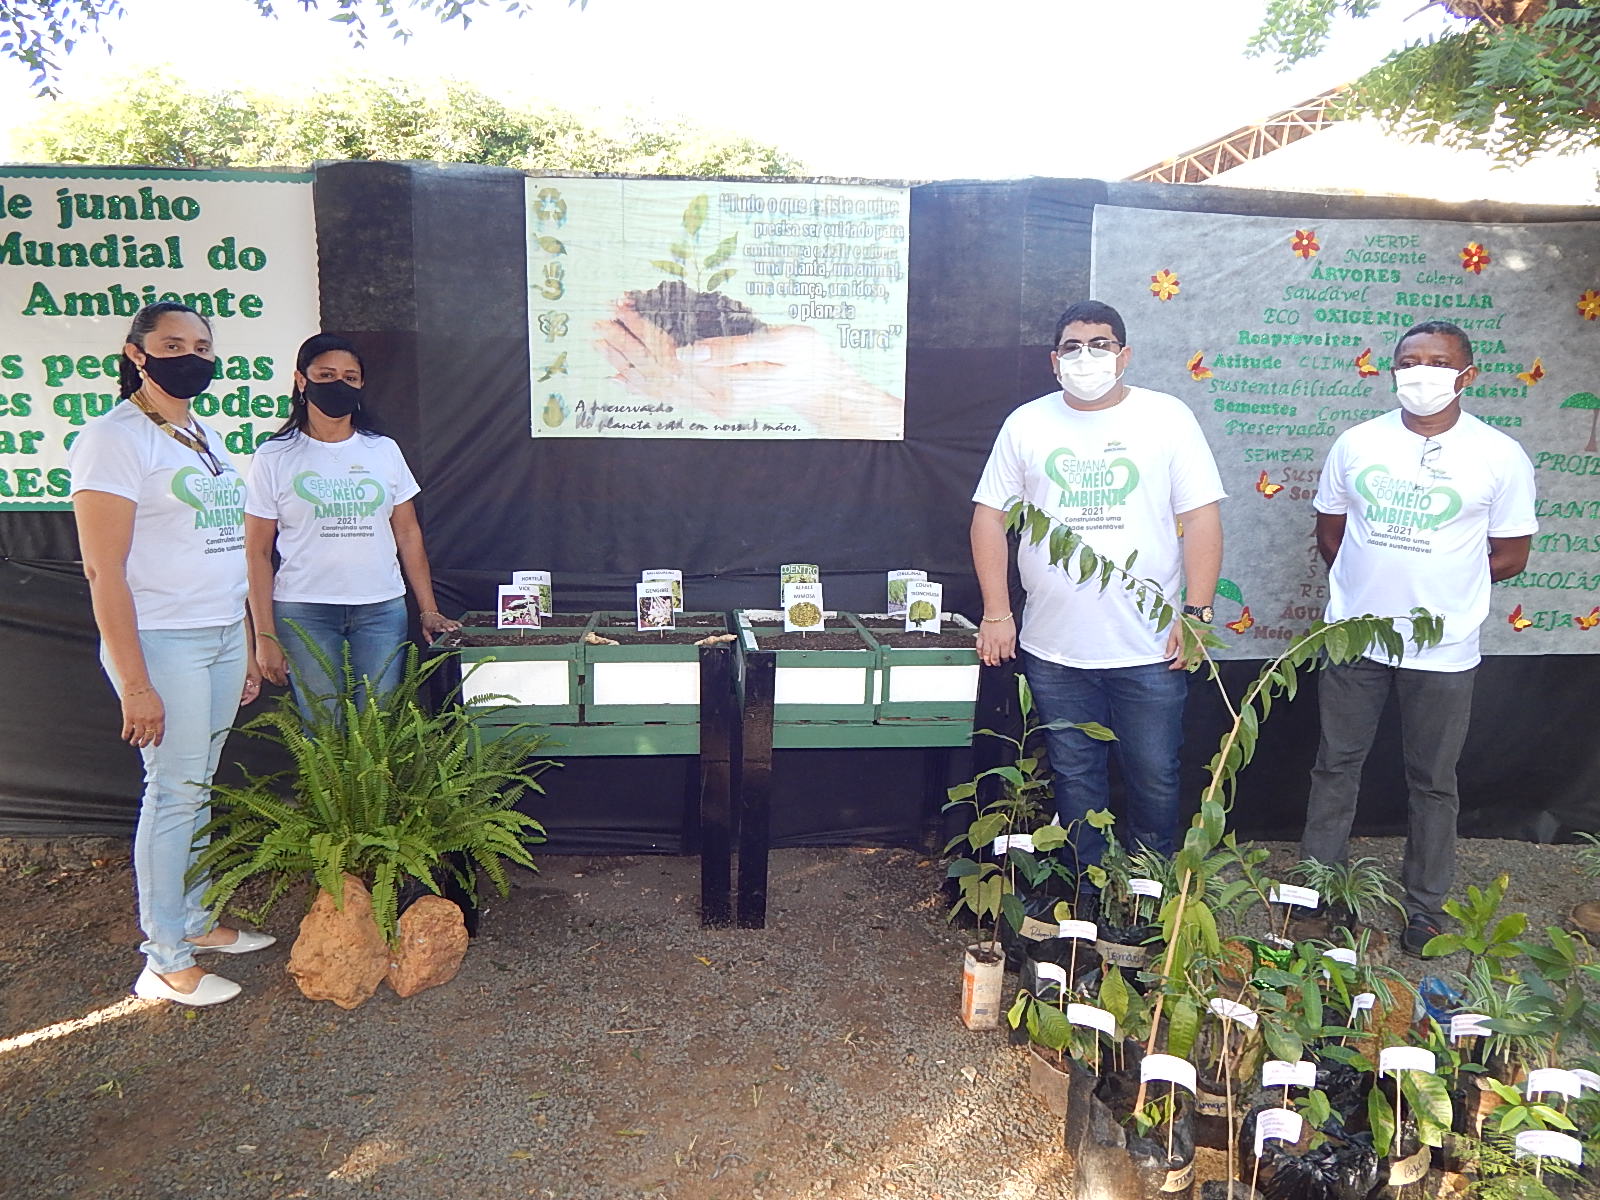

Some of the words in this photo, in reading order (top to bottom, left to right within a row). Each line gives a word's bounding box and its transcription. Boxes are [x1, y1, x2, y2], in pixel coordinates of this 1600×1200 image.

[56, 187, 200, 229] junho
[767, 199, 777, 213] o
[779, 197, 807, 215] que
[809, 194, 854, 215] existe
[856, 199, 867, 214] e
[754, 220, 800, 238] precisa
[801, 222, 823, 238] ser
[823, 221, 874, 238] cuidado
[874, 223, 905, 241] para
[1364, 234, 1420, 249] VERDE
[207, 236, 267, 271] do
[802, 245, 812, 259] a
[1343, 248, 1427, 265] Nascente
[754, 261, 785, 276] uma
[785, 260, 831, 278] planta,
[832, 262, 855, 277] um
[856, 261, 905, 280] animal,
[1311, 260, 1401, 283] ÁRVORES
[745, 281, 775, 297] uma
[775, 280, 828, 299] criança,
[828, 282, 851, 297] um
[851, 280, 890, 299] idoso,
[1395, 291, 1494, 310] RECICLAR
[788, 303, 799, 319] o
[800, 300, 857, 322] planeta
[1263, 307, 1301, 326] ECO
[1313, 305, 1414, 328] OXIGÊNIO
[1238, 330, 1363, 347] Reaproveitar
[1213, 353, 1283, 370] Atitude
[1208, 378, 1373, 398] Sustentabilidade
[575, 399, 586, 413] A
[1213, 398, 1298, 417] Sementes
[597, 415, 652, 434] planeta
[689, 420, 710, 432] em
[1224, 418, 1336, 439] Preservação
[1244, 447, 1315, 463] SEMEAR
[1062, 459, 1107, 473] SEMANA
[310, 478, 356, 490] SEMANA
[1068, 472, 1082, 485] DO
[1082, 469, 1115, 489] MEIO
[1371, 475, 1425, 495] SEMANA
[214, 488, 241, 507] MEIO
[319, 488, 332, 499] DO
[333, 486, 366, 501] MEIO
[1058, 488, 1127, 508] AMBIENTE
[1376, 487, 1393, 501] DO
[1392, 491, 1432, 512] MEIO
[336, 517, 357, 525] 2021
[1064, 516, 1105, 524] Construindo
[1081, 507, 1104, 516] 2021
[219, 526, 235, 537] 2021
[1370, 530, 1412, 543] Construindo
[1412, 538, 1431, 546] uma
[1386, 524, 1412, 536] 2021
[1532, 610, 1573, 632] EJA
[1252, 624, 1294, 640] Meio
